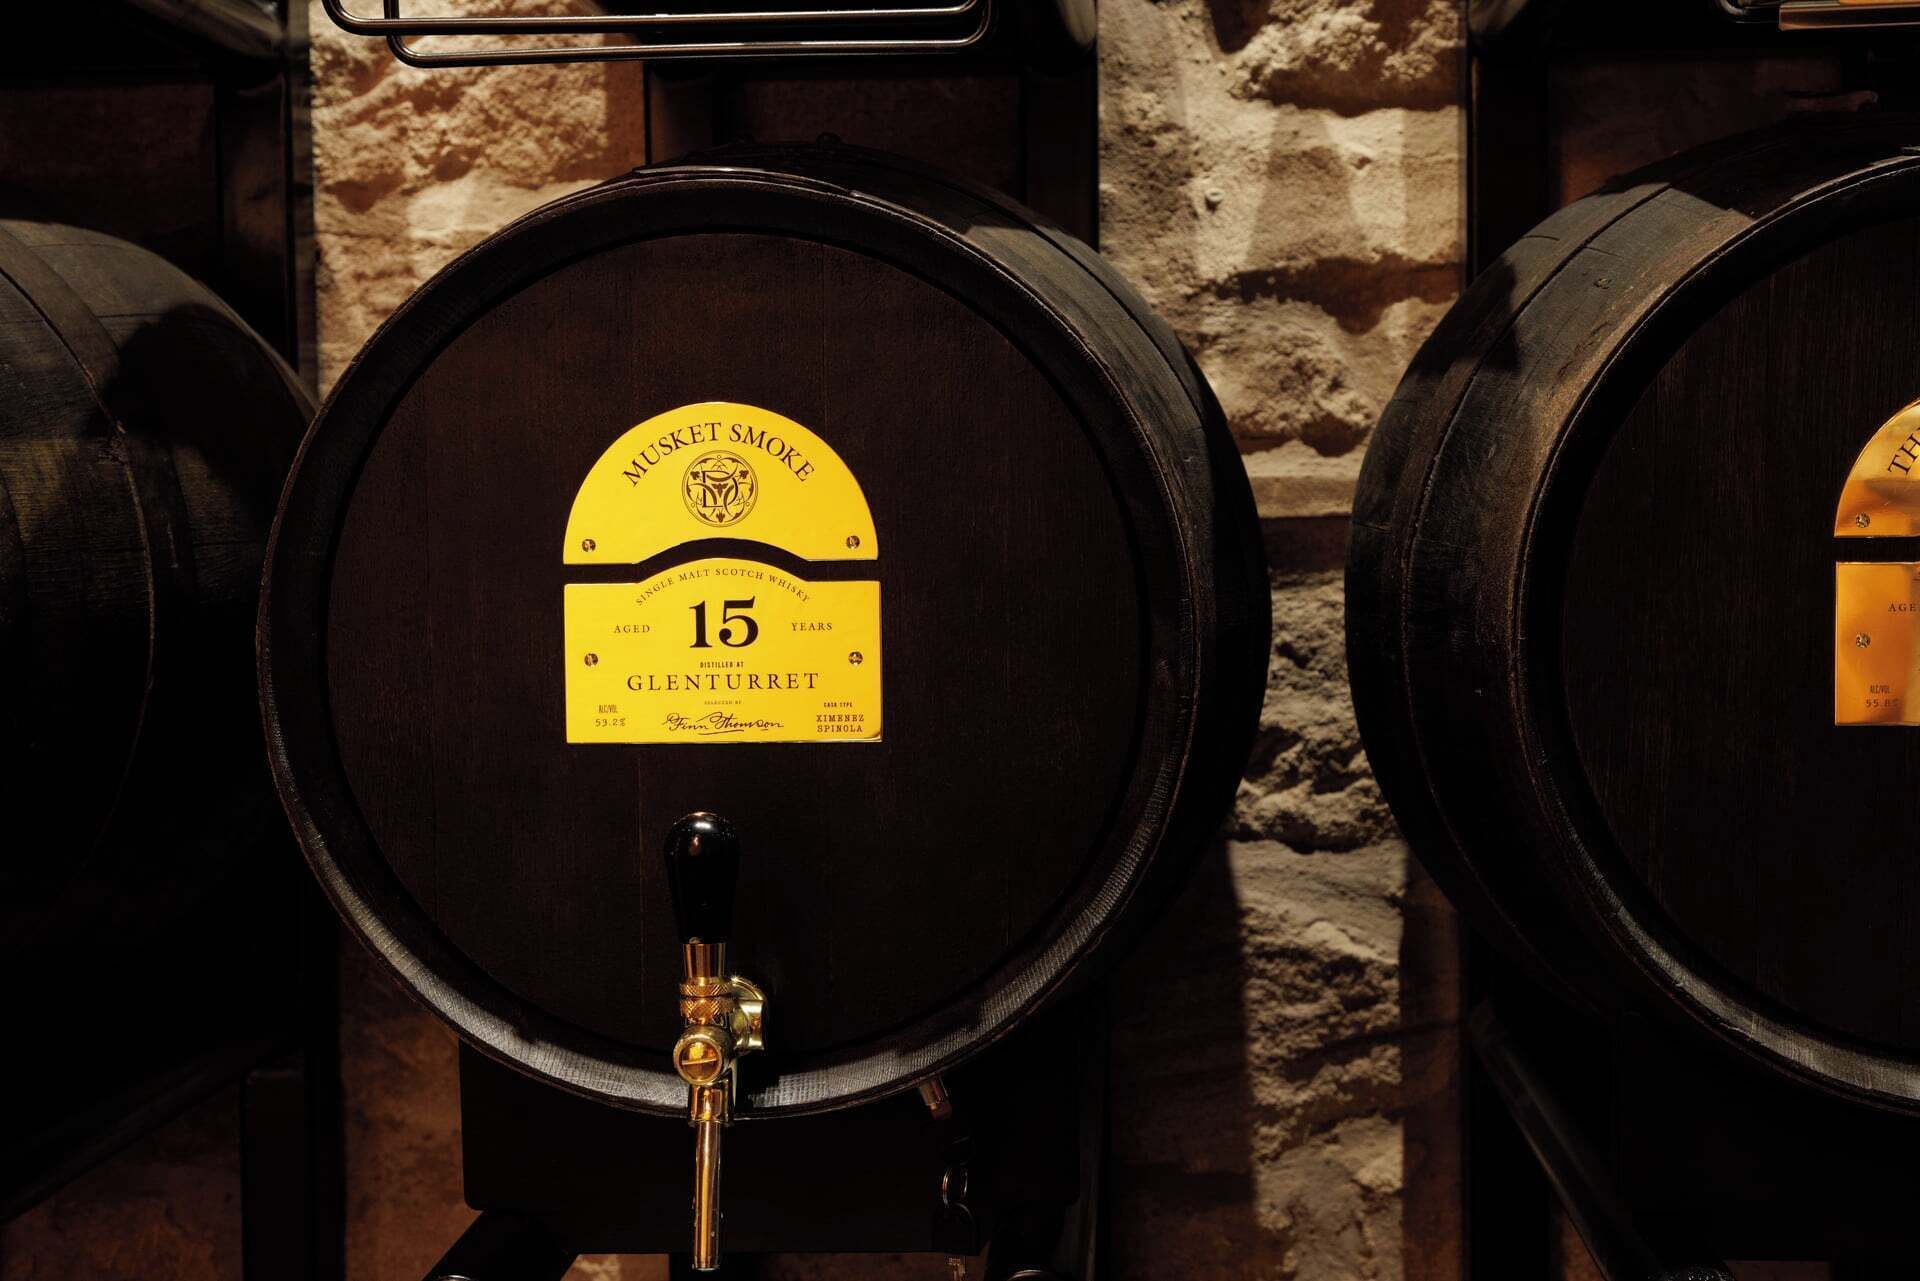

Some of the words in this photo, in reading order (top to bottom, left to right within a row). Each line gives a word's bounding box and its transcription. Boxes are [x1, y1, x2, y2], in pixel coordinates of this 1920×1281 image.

[622, 422, 722, 487] MUSKET
[728, 423, 816, 482] SMOKE
[1887, 427, 1920, 476] TH
[635, 577, 674, 606] SINGLE
[678, 568, 710, 582] MALT
[715, 568, 764, 580] SCOTCH
[768, 574, 810, 603] WHISKY
[1887, 602, 1920, 613] AGE
[614, 624, 651, 633] AGED
[689, 596, 759, 649] 15
[791, 622, 833, 631] YEARS
[627, 672, 819, 691] GLENTURRET
[595, 718, 626, 727] 59.2%
[662, 712, 709, 731] Finn
[816, 714, 864, 722] XIMENEZ
[817, 724, 863, 732] SPINOLA
